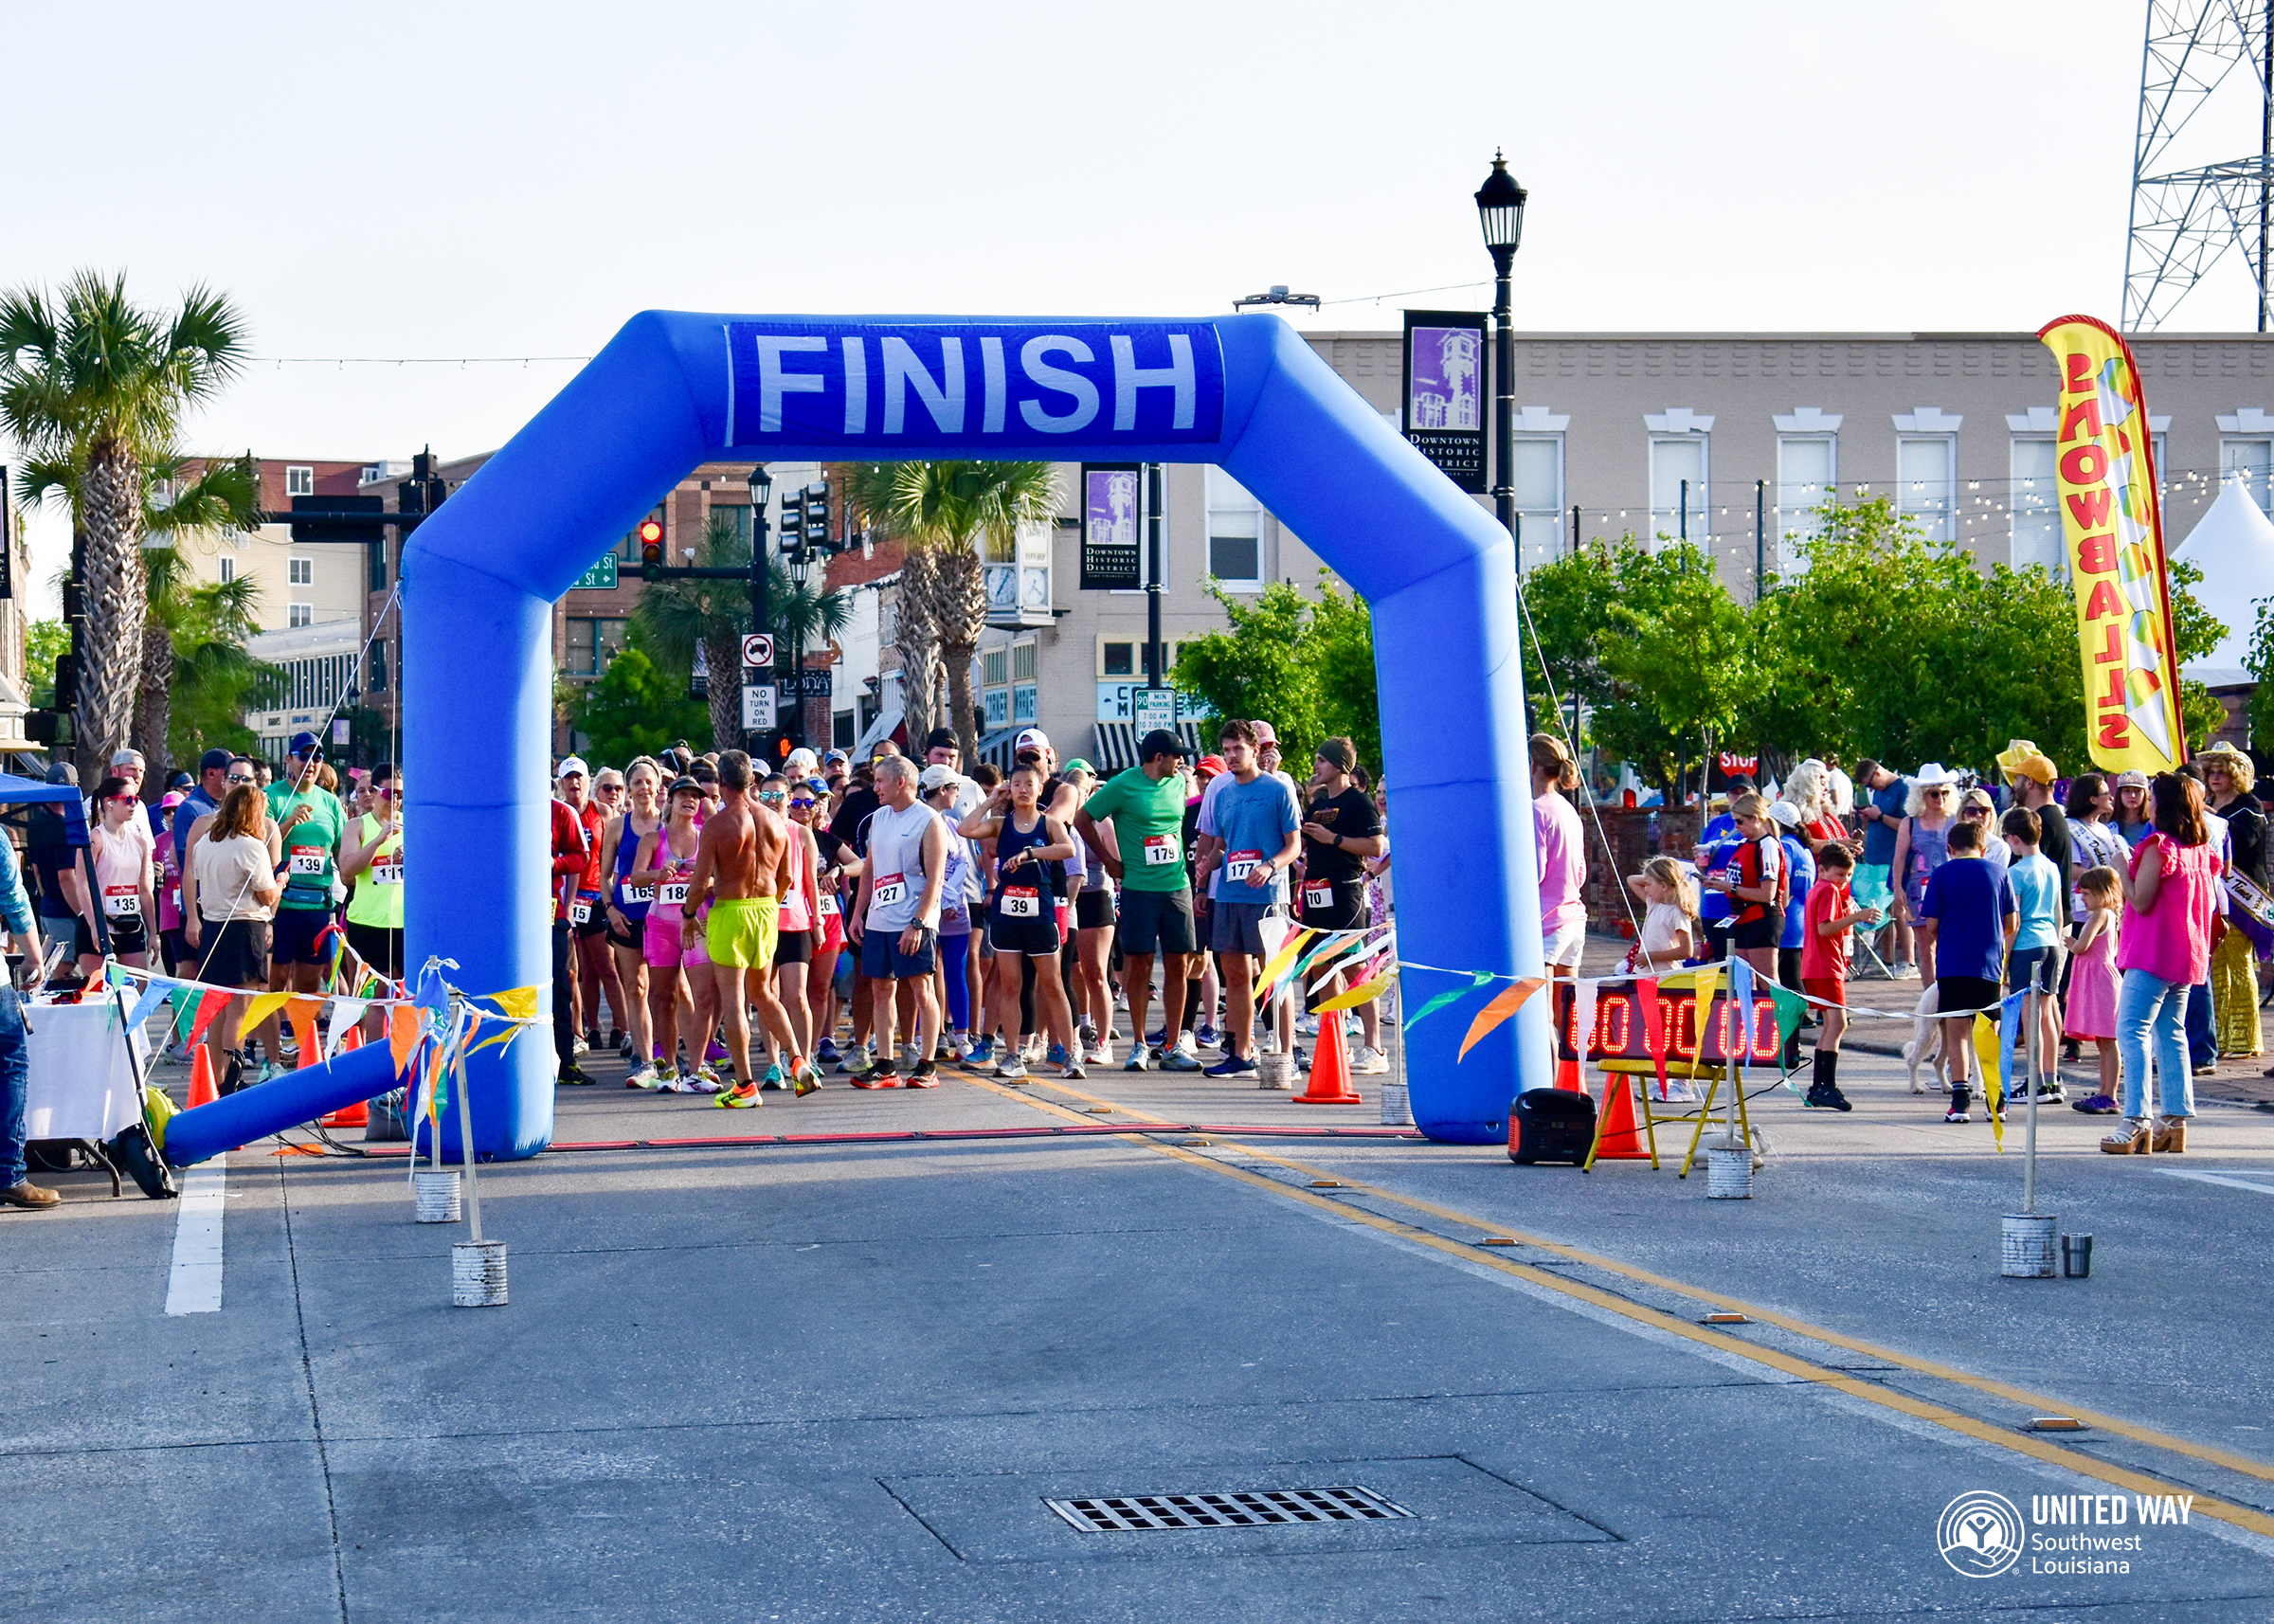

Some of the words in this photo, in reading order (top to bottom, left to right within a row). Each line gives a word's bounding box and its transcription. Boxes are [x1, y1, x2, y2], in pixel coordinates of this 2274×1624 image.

[756, 334, 1197, 434] FINISH
[1416, 445, 1480, 457] ISTORIC
[1087, 547, 1137, 555] DOWNTOWN
[604, 556, 613, 569] St
[1087, 555, 1137, 564] HISTORIC
[586, 572, 596, 586] St
[752, 690, 767, 698] NO
[1137, 695, 1148, 706] 90
[1152, 847, 1175, 861] 179
[298, 857, 320, 872] 139
[1231, 863, 1255, 877] 177
[630, 885, 655, 899] 165
[877, 886, 898, 902] 127
[1308, 893, 1322, 905] 70
[114, 897, 135, 911] 135
[1011, 899, 1028, 913] 39
